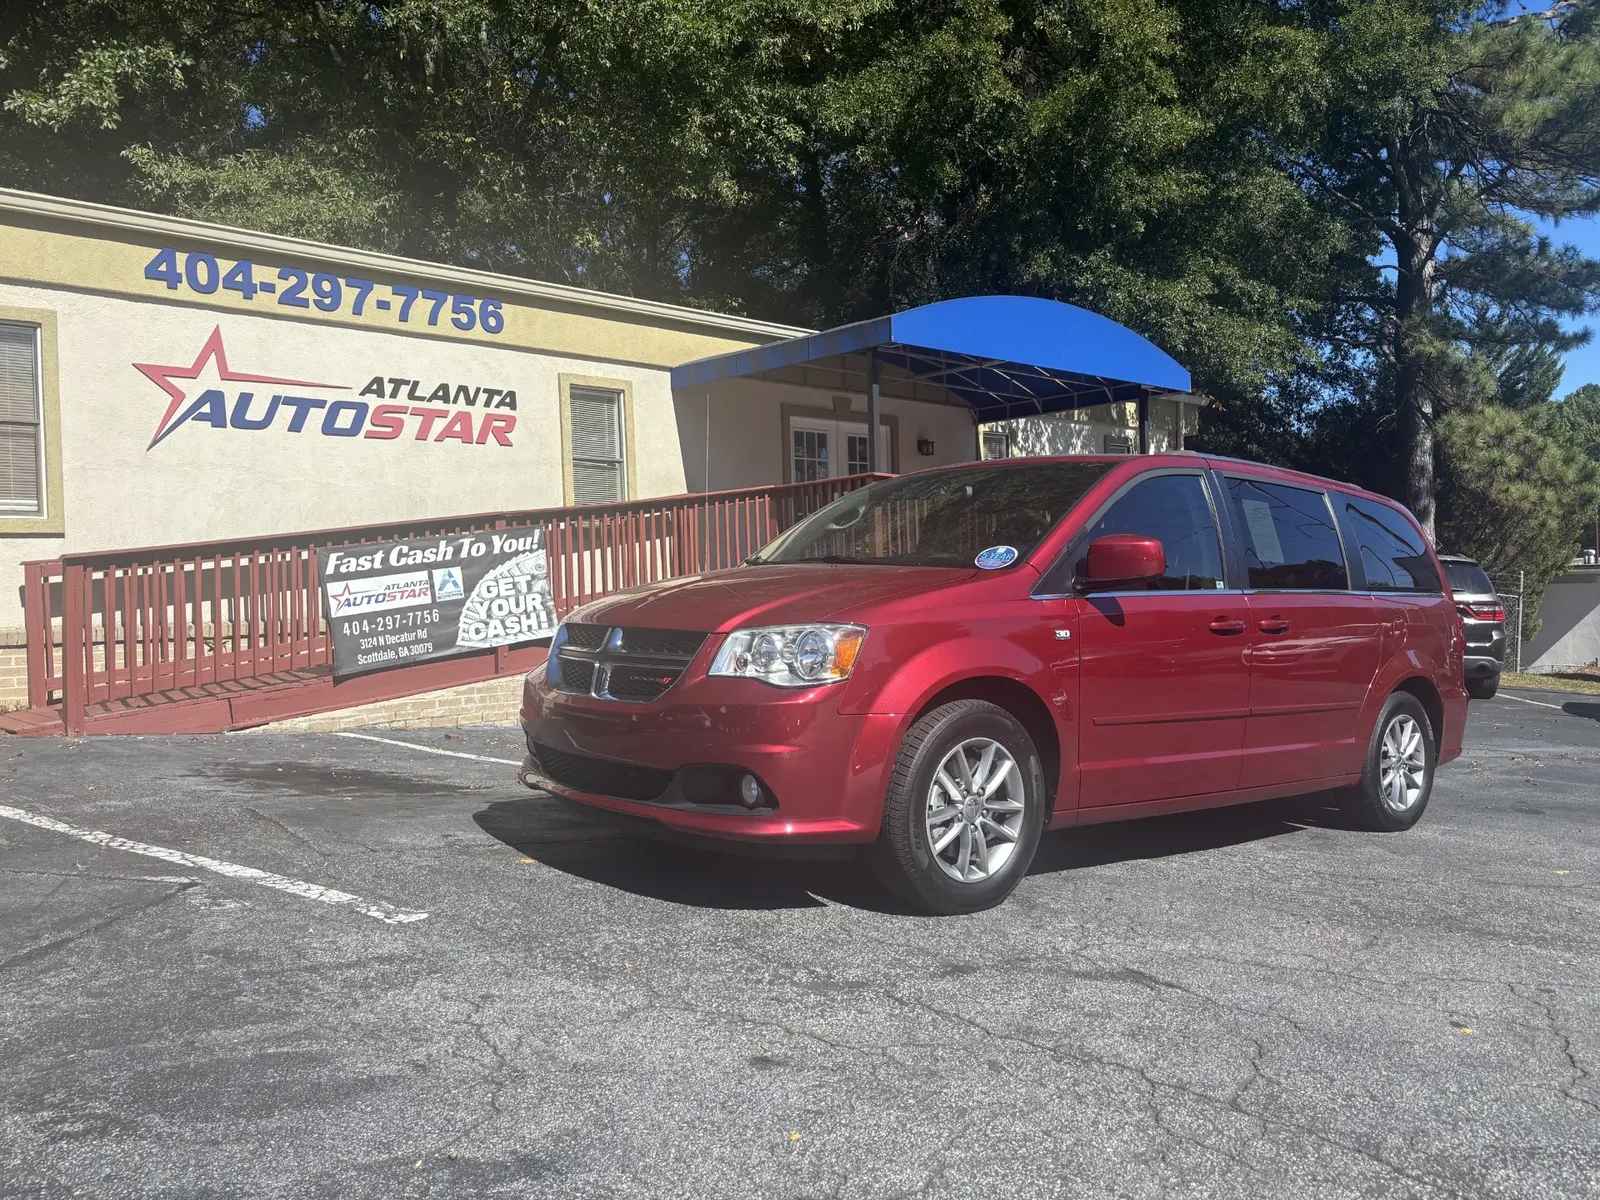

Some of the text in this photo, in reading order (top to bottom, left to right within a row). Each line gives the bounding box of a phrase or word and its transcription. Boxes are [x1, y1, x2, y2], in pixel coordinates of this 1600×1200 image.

[144, 247, 505, 334] 404-297-7756
[359, 376, 518, 411] ATLANTA
[160, 389, 518, 448] AUTOSTAR
[325, 528, 541, 575] Fast Cash To You!
[990, 552, 1014, 560] YEAR
[342, 587, 429, 608] AUTOSTAR
[383, 579, 429, 591] ATLANTA
[480, 575, 532, 599] GET
[473, 593, 544, 620] YOUR
[343, 609, 440, 637] 404-297-7756
[468, 610, 549, 640] CASH!
[1055, 629, 1070, 638] 30
[359, 628, 428, 649] 3124 N Decatur Rd
[357, 642, 433, 665] Scottdale, GA 30079
